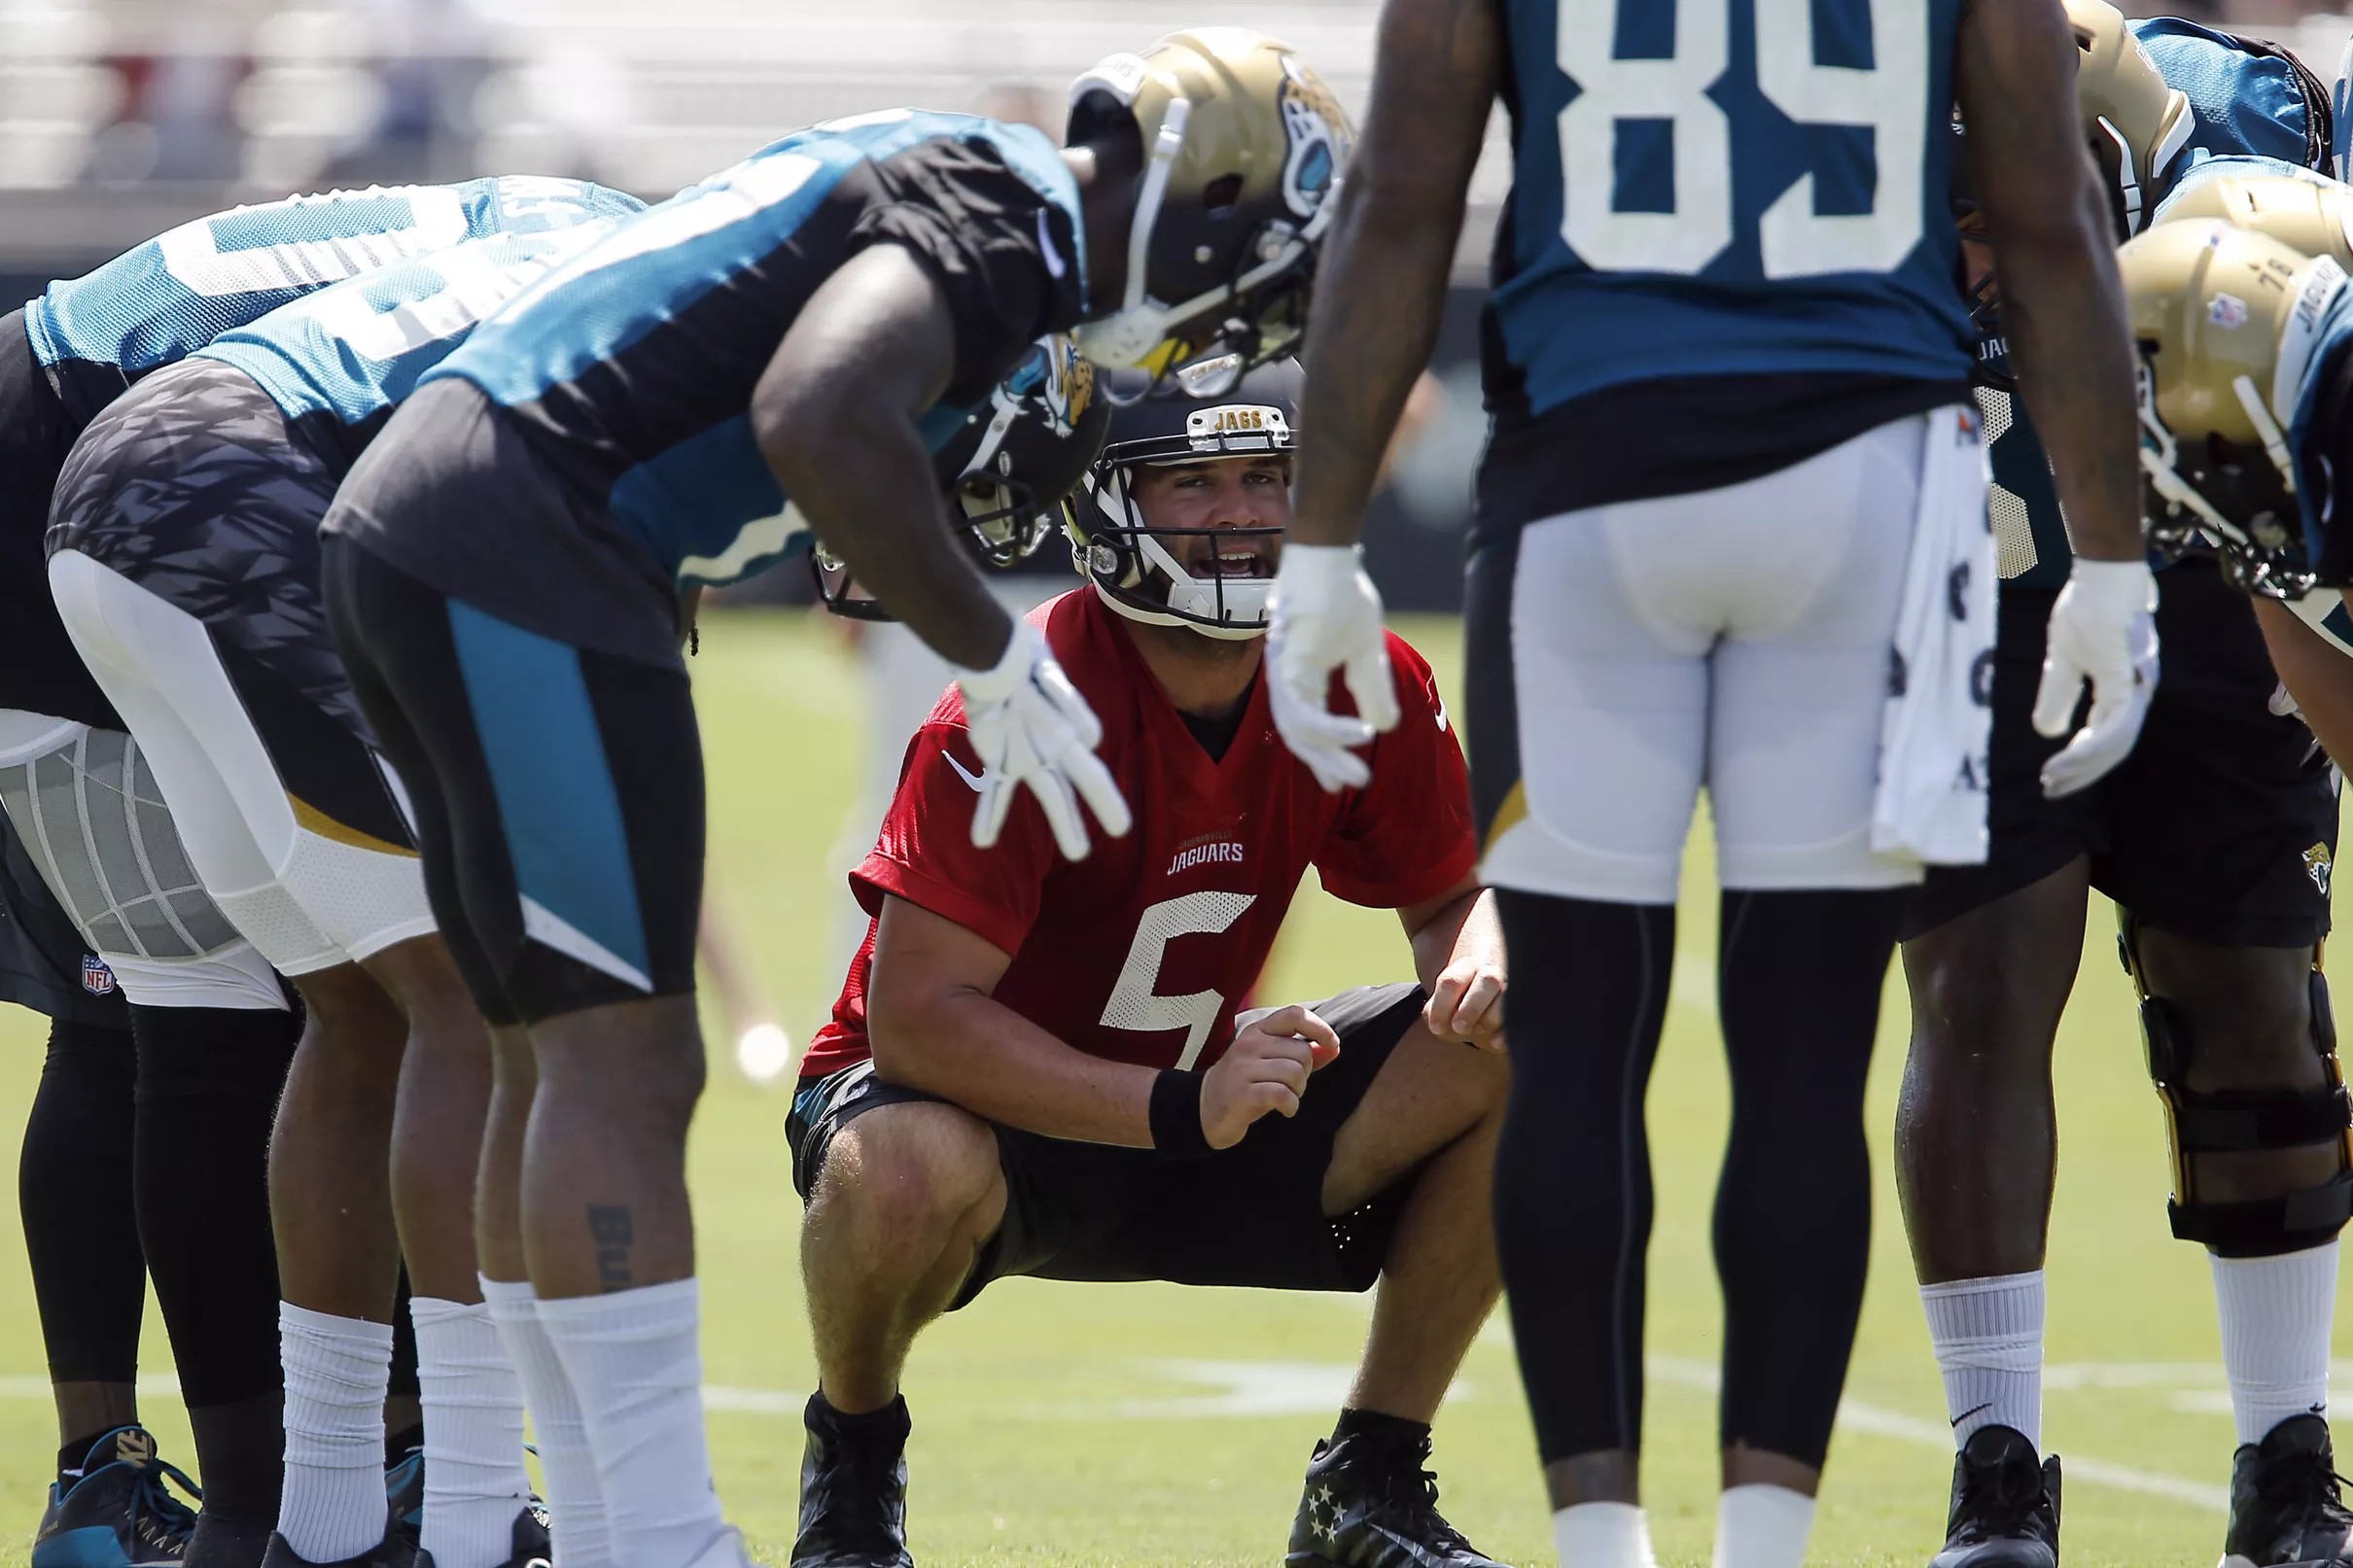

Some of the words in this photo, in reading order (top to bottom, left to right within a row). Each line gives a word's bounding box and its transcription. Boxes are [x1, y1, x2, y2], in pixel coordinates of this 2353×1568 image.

[1557, 0, 1929, 281] 89
[1213, 410, 1262, 431] JAGS
[1167, 842, 1244, 876] JAGUARS
[87, 970, 111, 990] NFL
